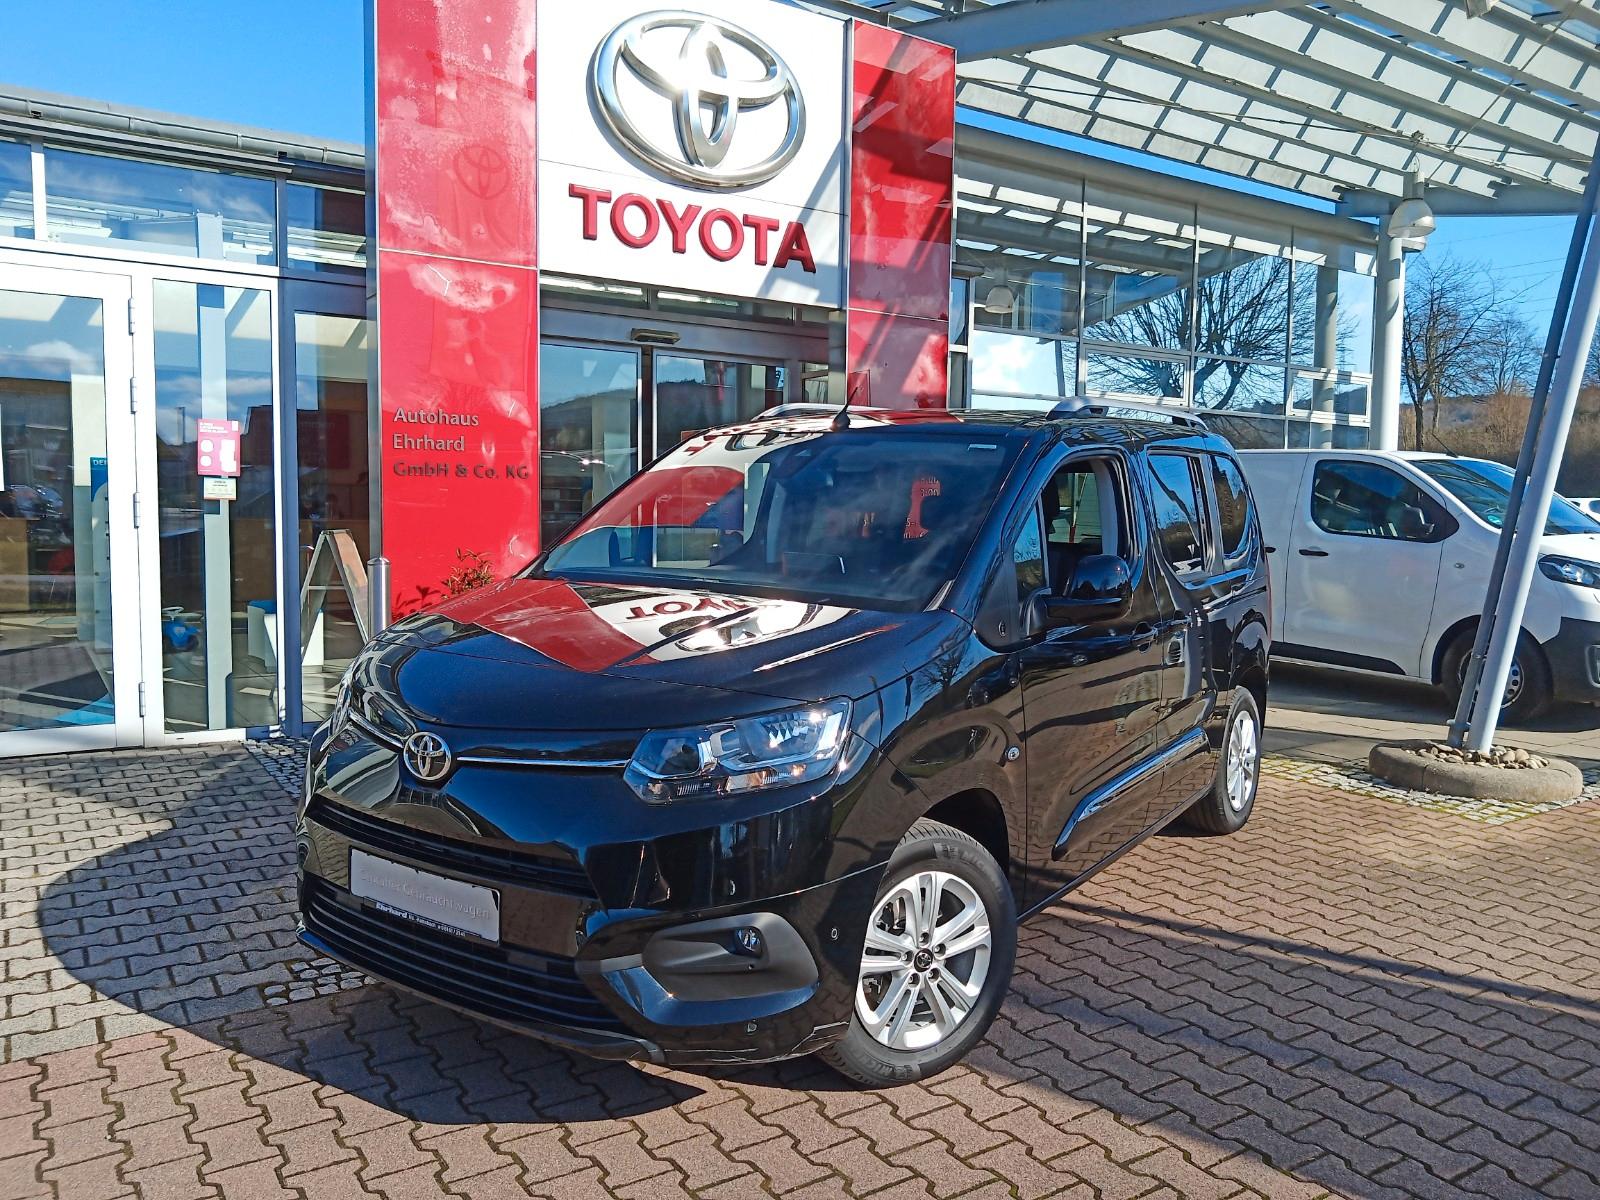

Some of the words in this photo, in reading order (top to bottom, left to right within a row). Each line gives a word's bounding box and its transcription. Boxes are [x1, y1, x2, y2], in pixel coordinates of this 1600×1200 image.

[568, 182, 816, 273] TOYOTA
[393, 407, 479, 426] Autohaus
[392, 433, 465, 451] Ehrhard
[393, 461, 449, 477] GmbH
[455, 464, 467, 477] &
[473, 465, 499, 479] Co.
[506, 464, 529, 479] KG
